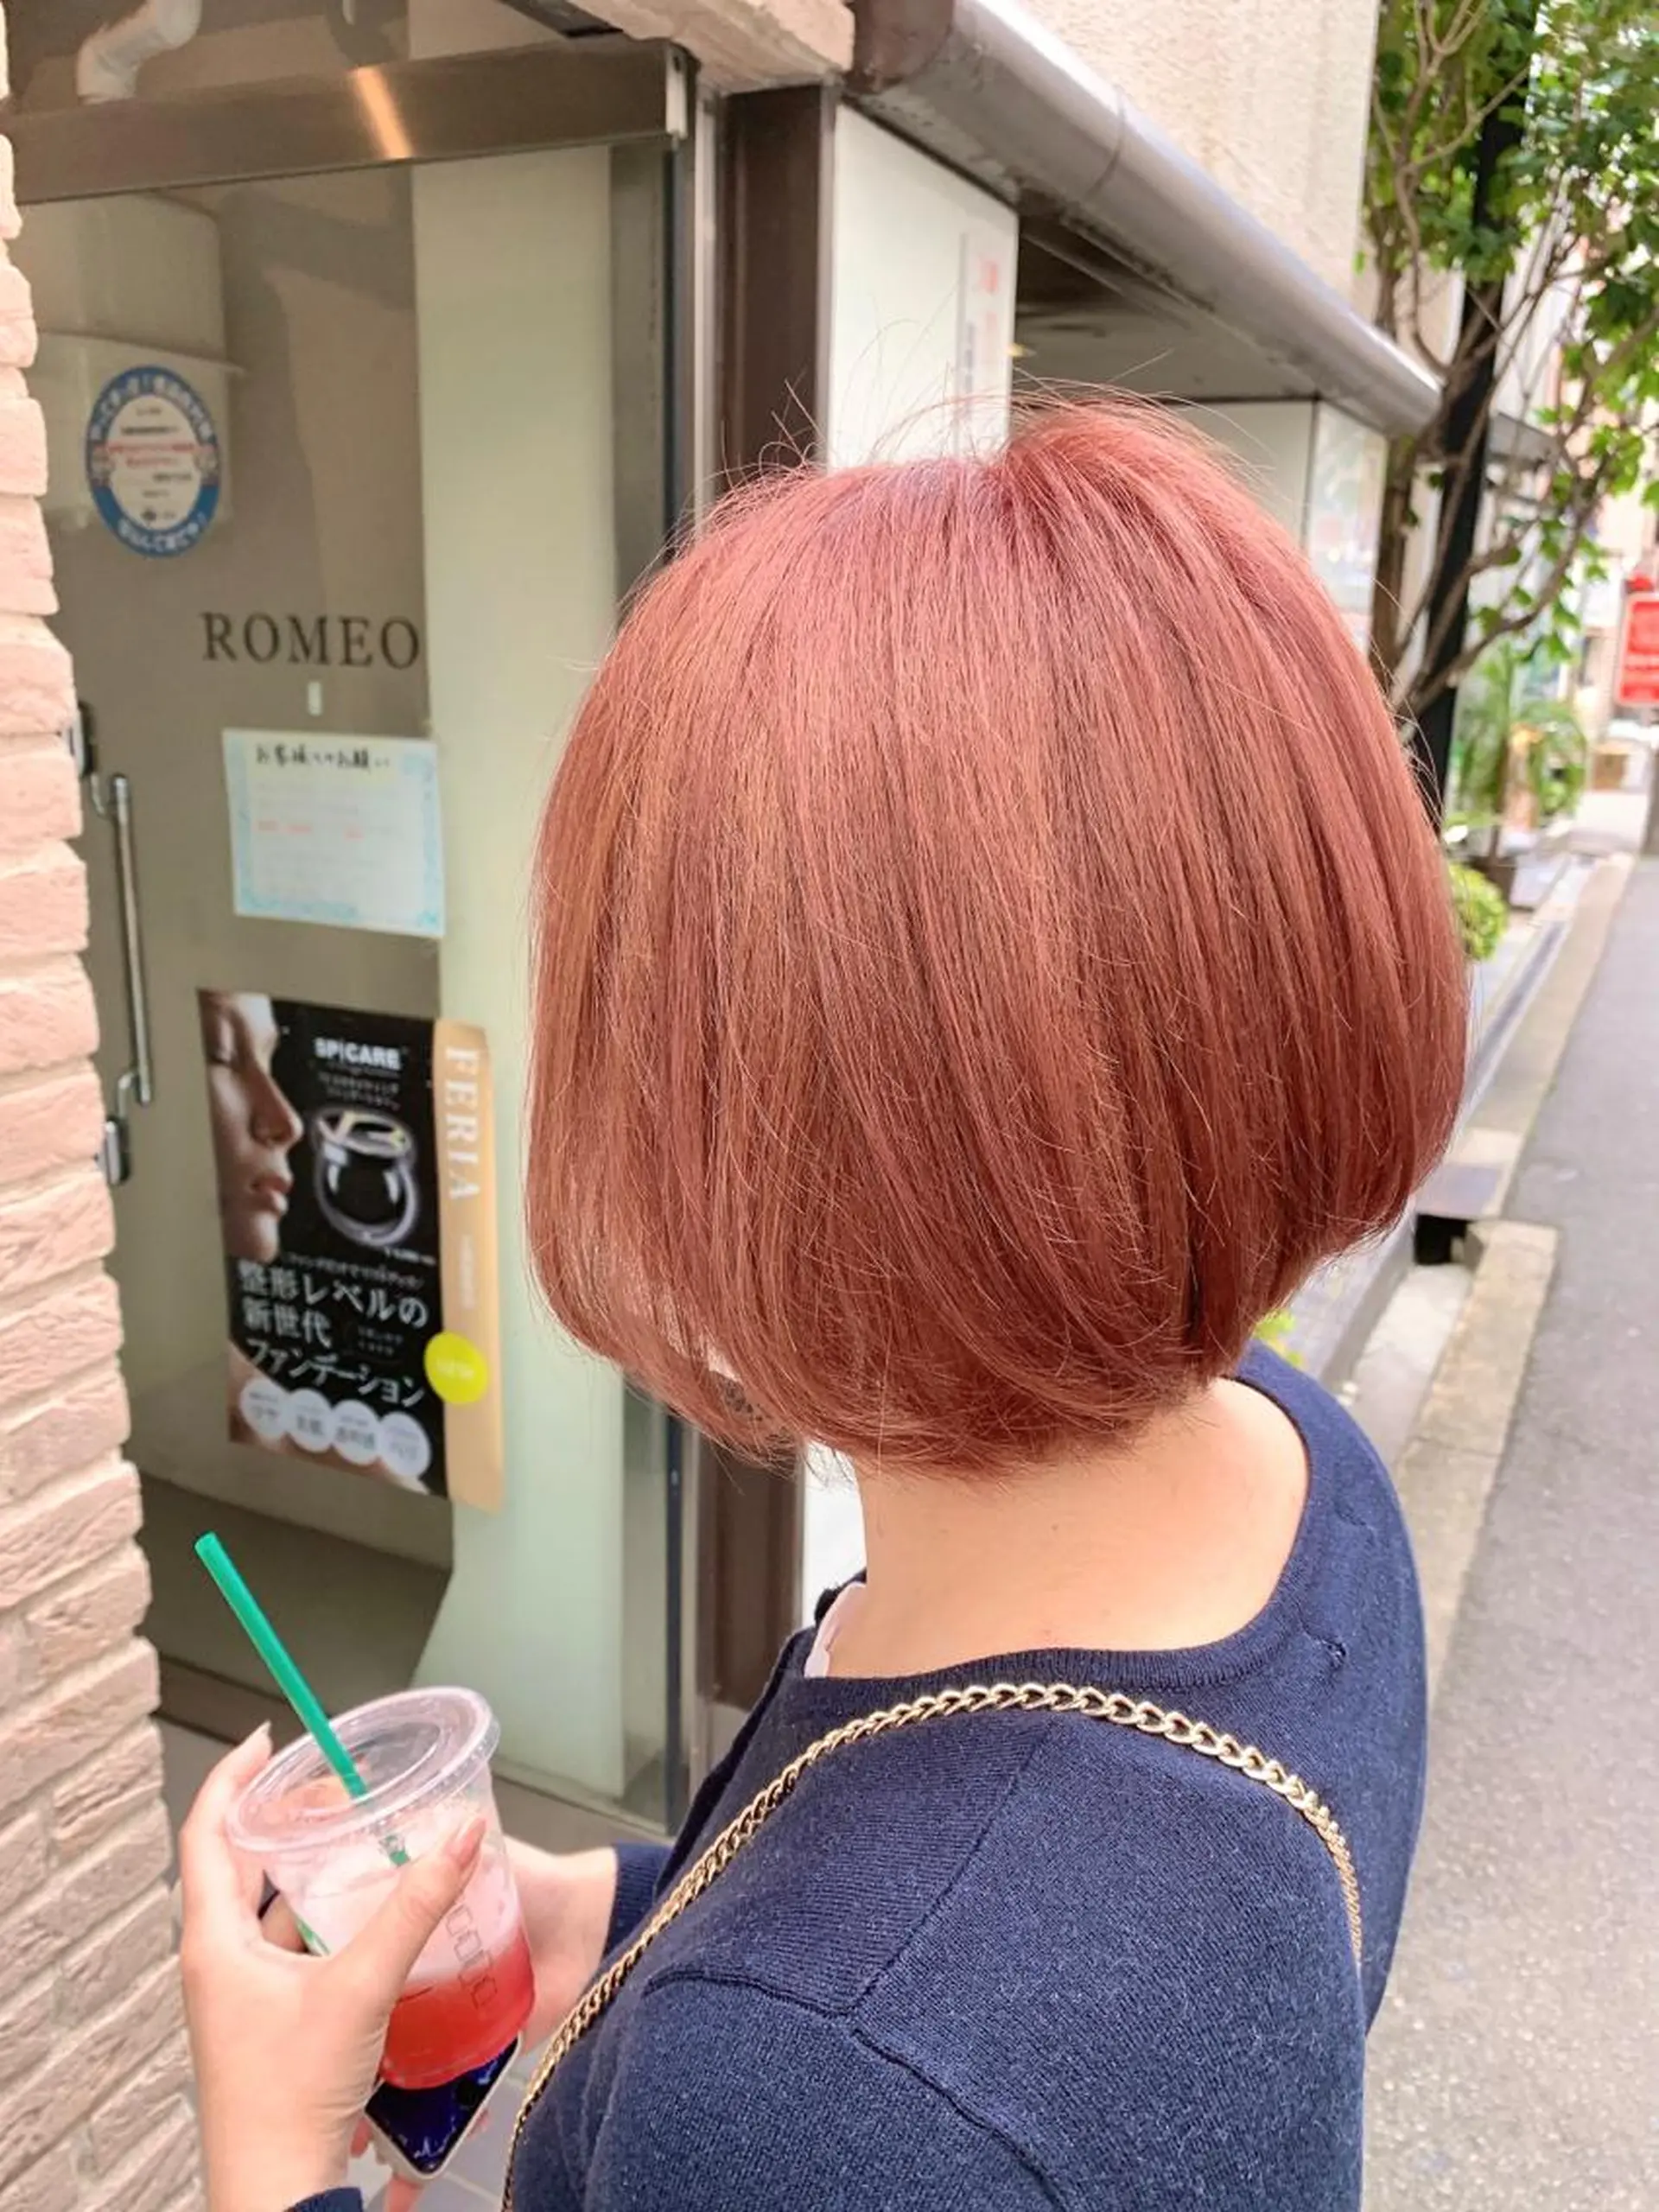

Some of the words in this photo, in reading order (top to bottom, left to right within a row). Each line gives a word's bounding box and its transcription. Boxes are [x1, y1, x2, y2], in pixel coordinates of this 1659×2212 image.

[201, 612, 420, 670] ROMEO
[445, 1046, 480, 1199] FERIA
[242, 1296, 333, 1348] 新世代
[246, 1338, 425, 1407] ファンデーション
